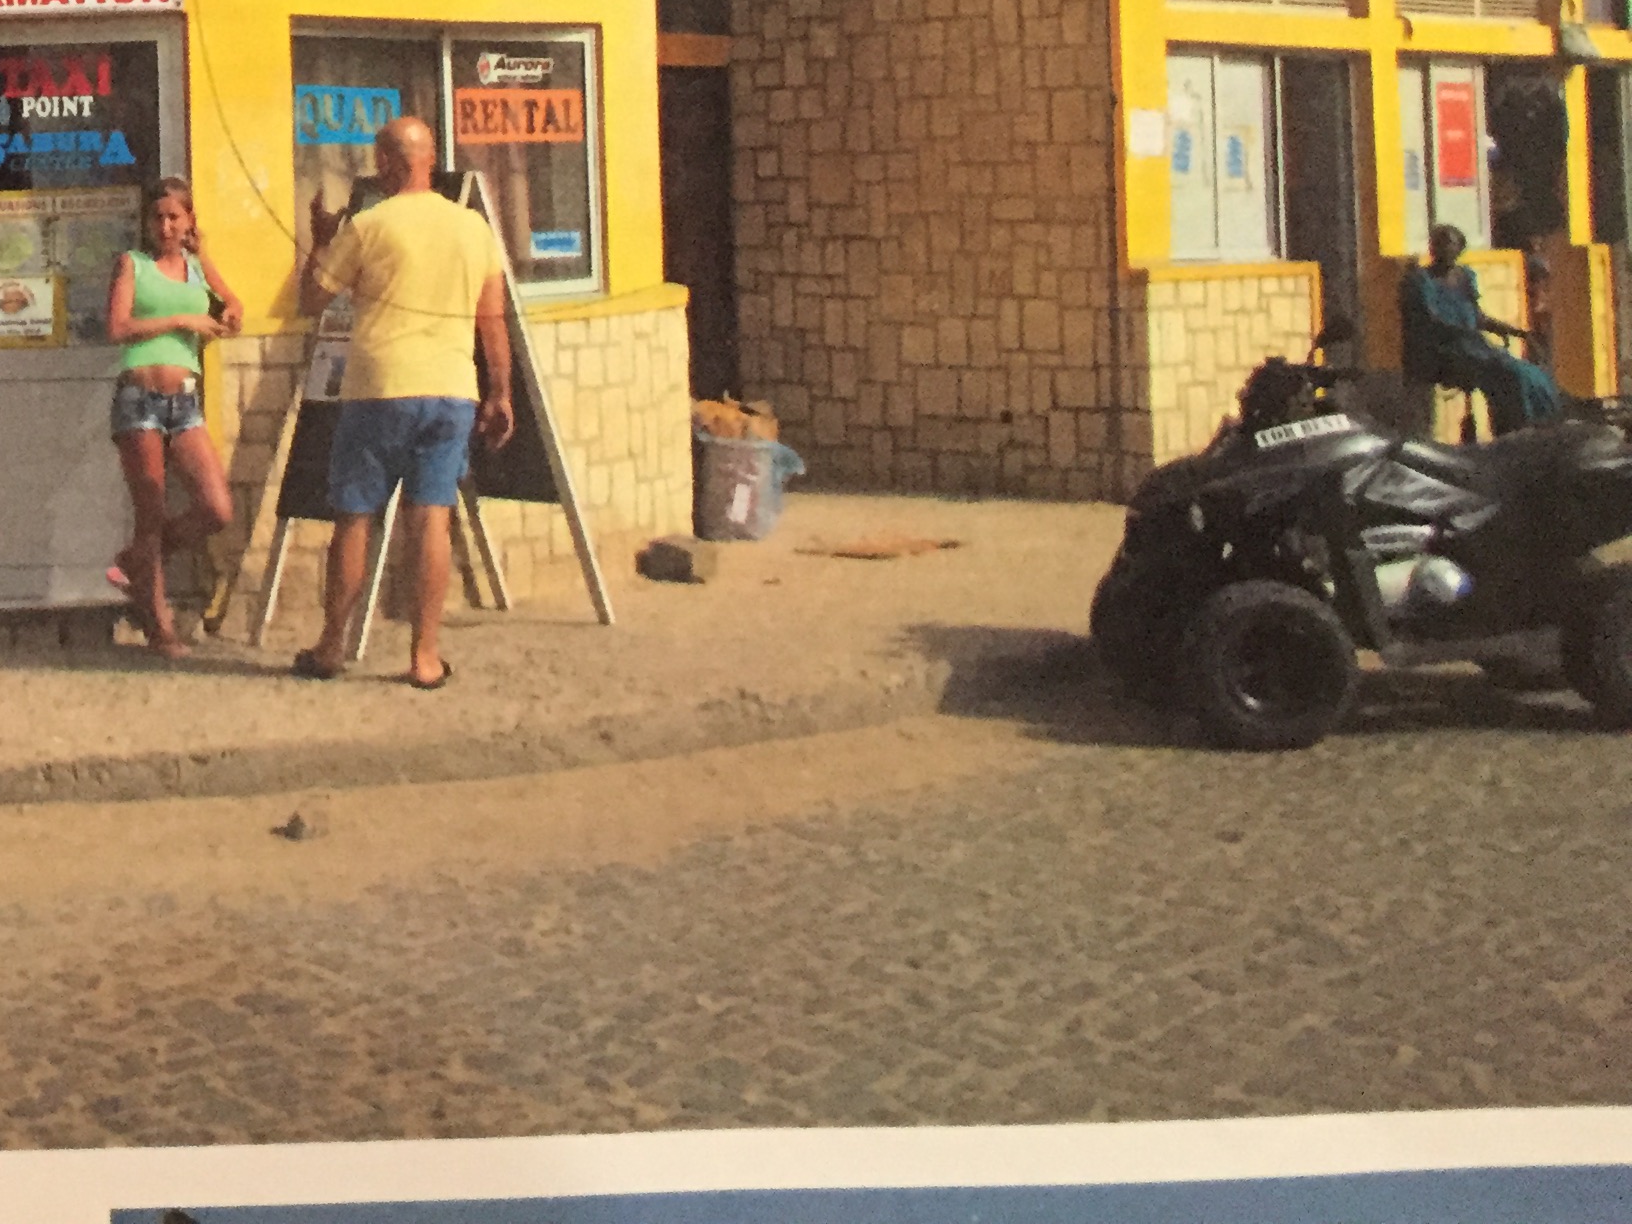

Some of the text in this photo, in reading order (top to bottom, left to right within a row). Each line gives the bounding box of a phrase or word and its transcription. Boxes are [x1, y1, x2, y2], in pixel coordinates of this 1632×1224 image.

[21, 96, 94, 118] POINT
[299, 91, 393, 140] QUAD
[460, 96, 581, 136] RENTAL
